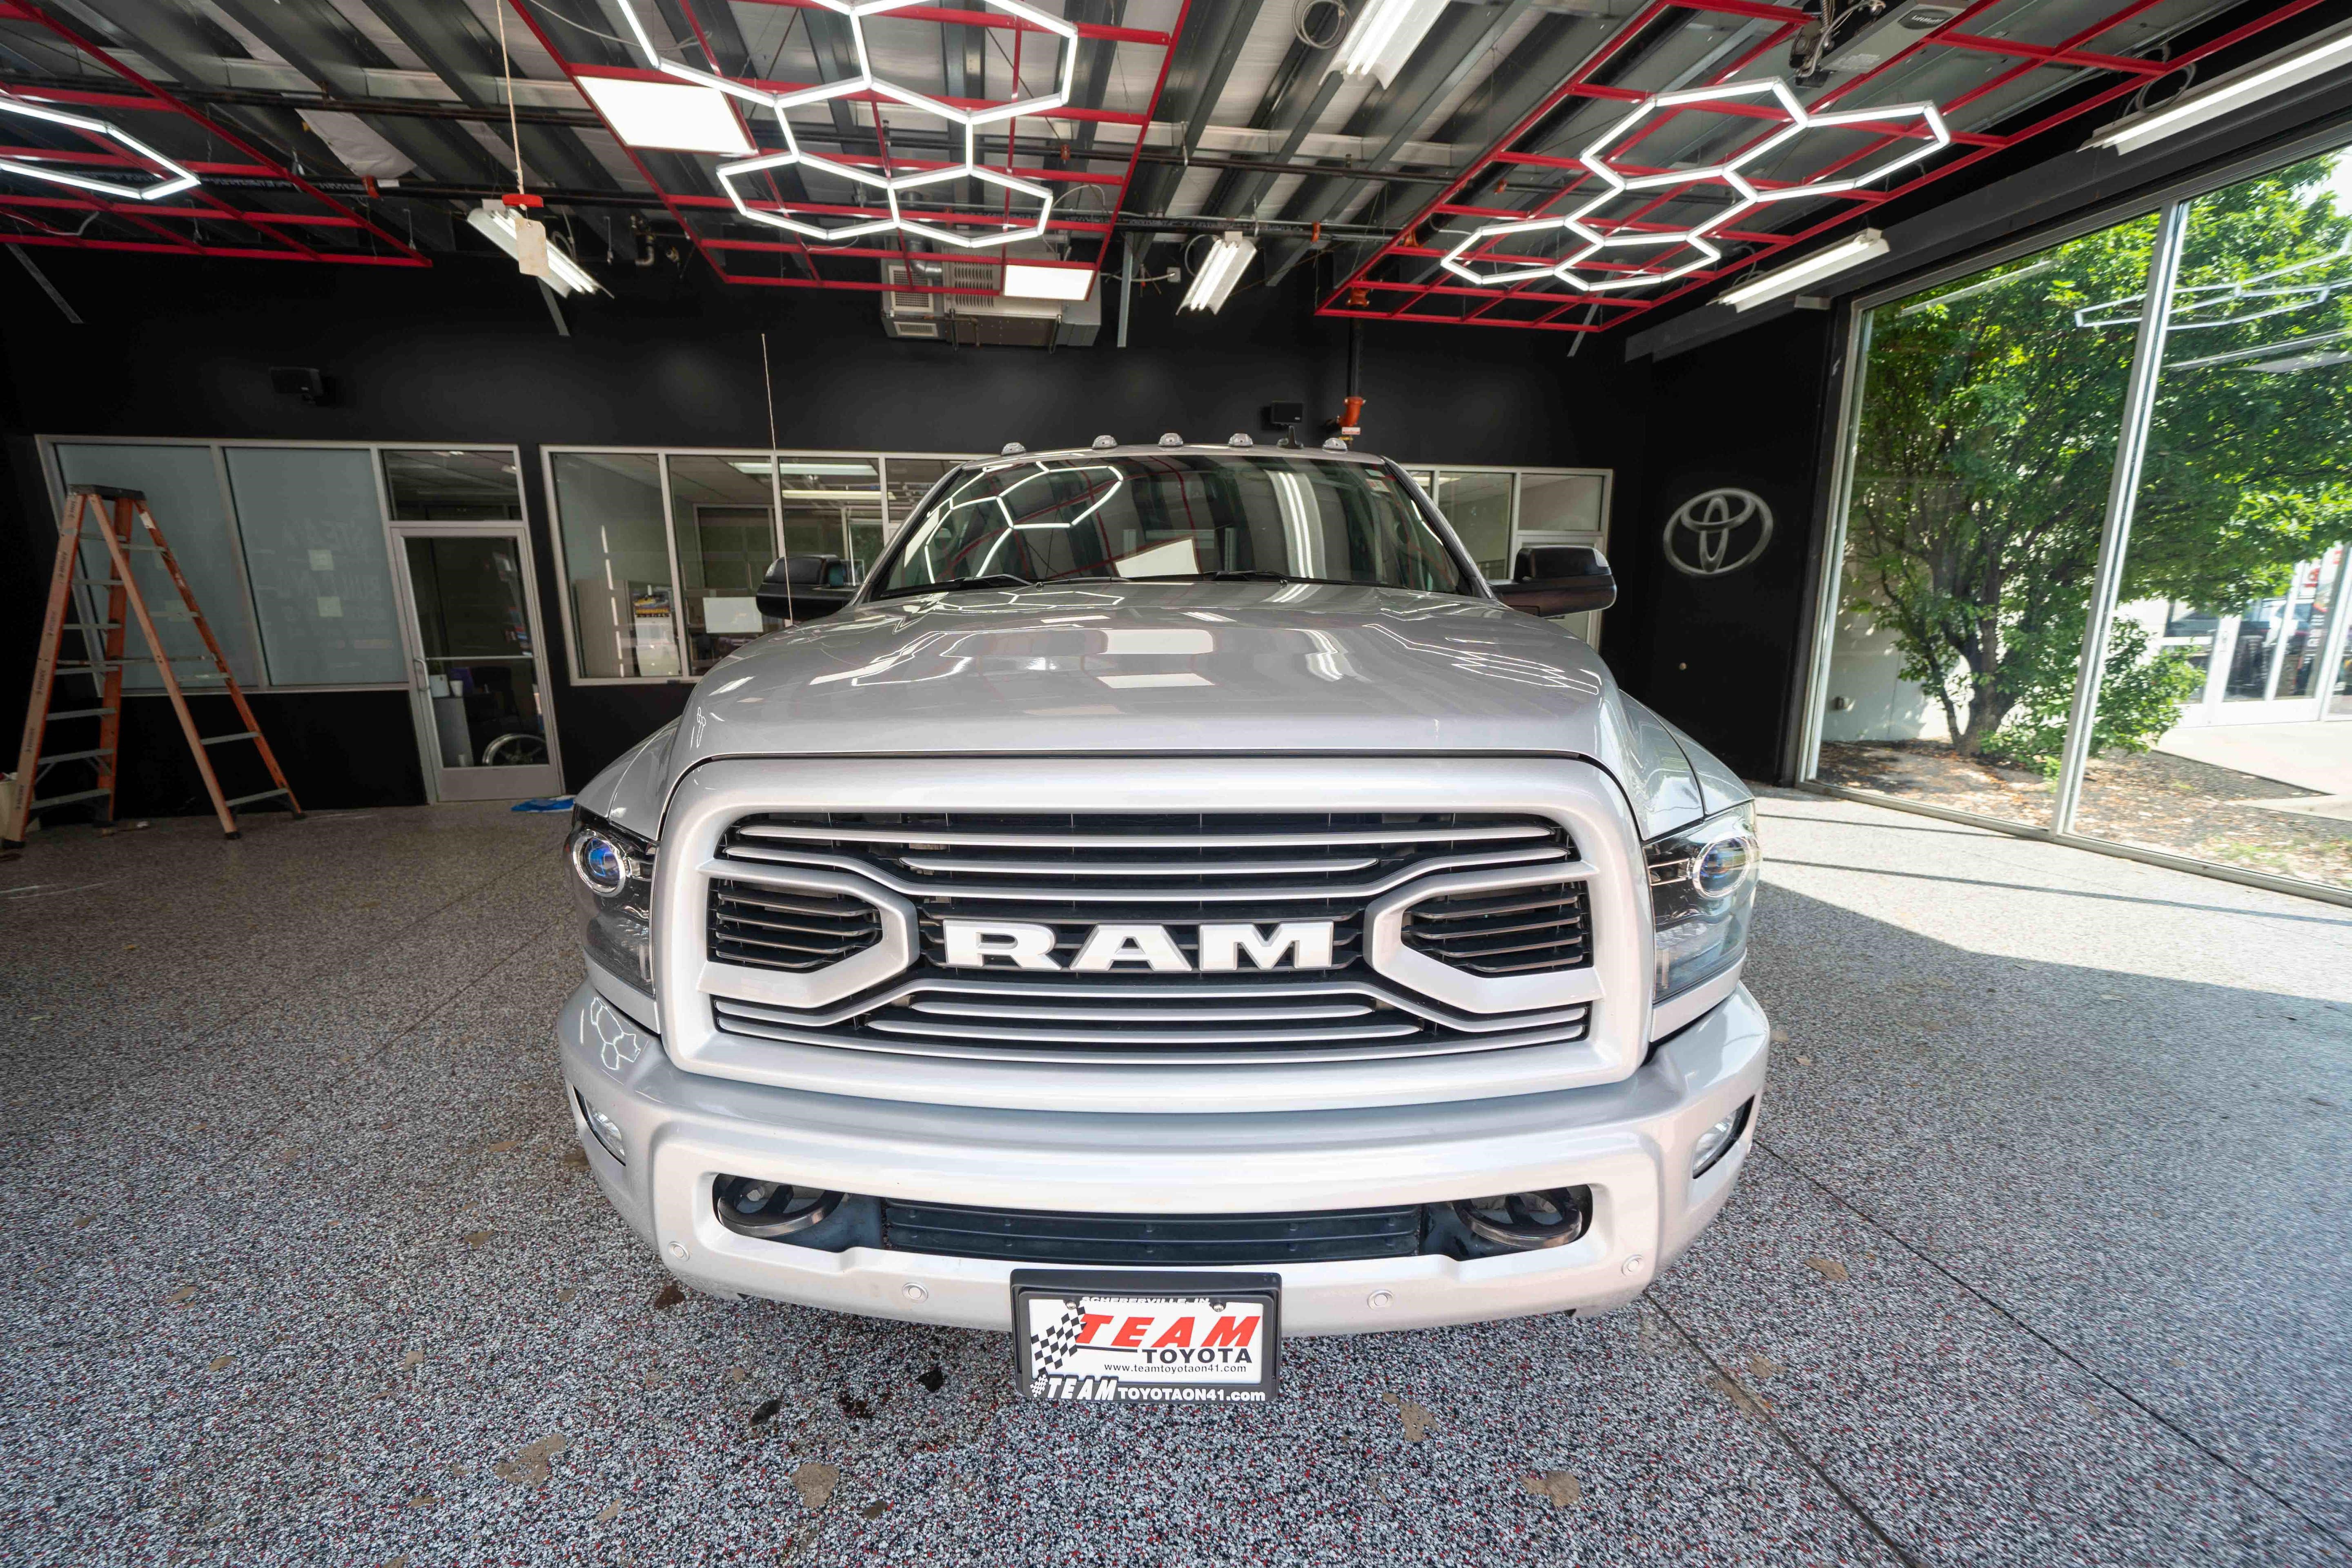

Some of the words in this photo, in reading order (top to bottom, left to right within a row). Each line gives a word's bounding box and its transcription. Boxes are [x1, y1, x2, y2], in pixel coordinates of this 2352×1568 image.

[942, 919, 1334, 972] RAM
[1076, 1313, 1261, 1348] TEAM
[1142, 1348, 1252, 1364] TOYOTA
[1104, 1364, 1247, 1374] www.teamtoyotaon41.com
[1047, 1377, 1118, 1401] TEAM
[1118, 1387, 1266, 1401] TOYOTAON41.com
